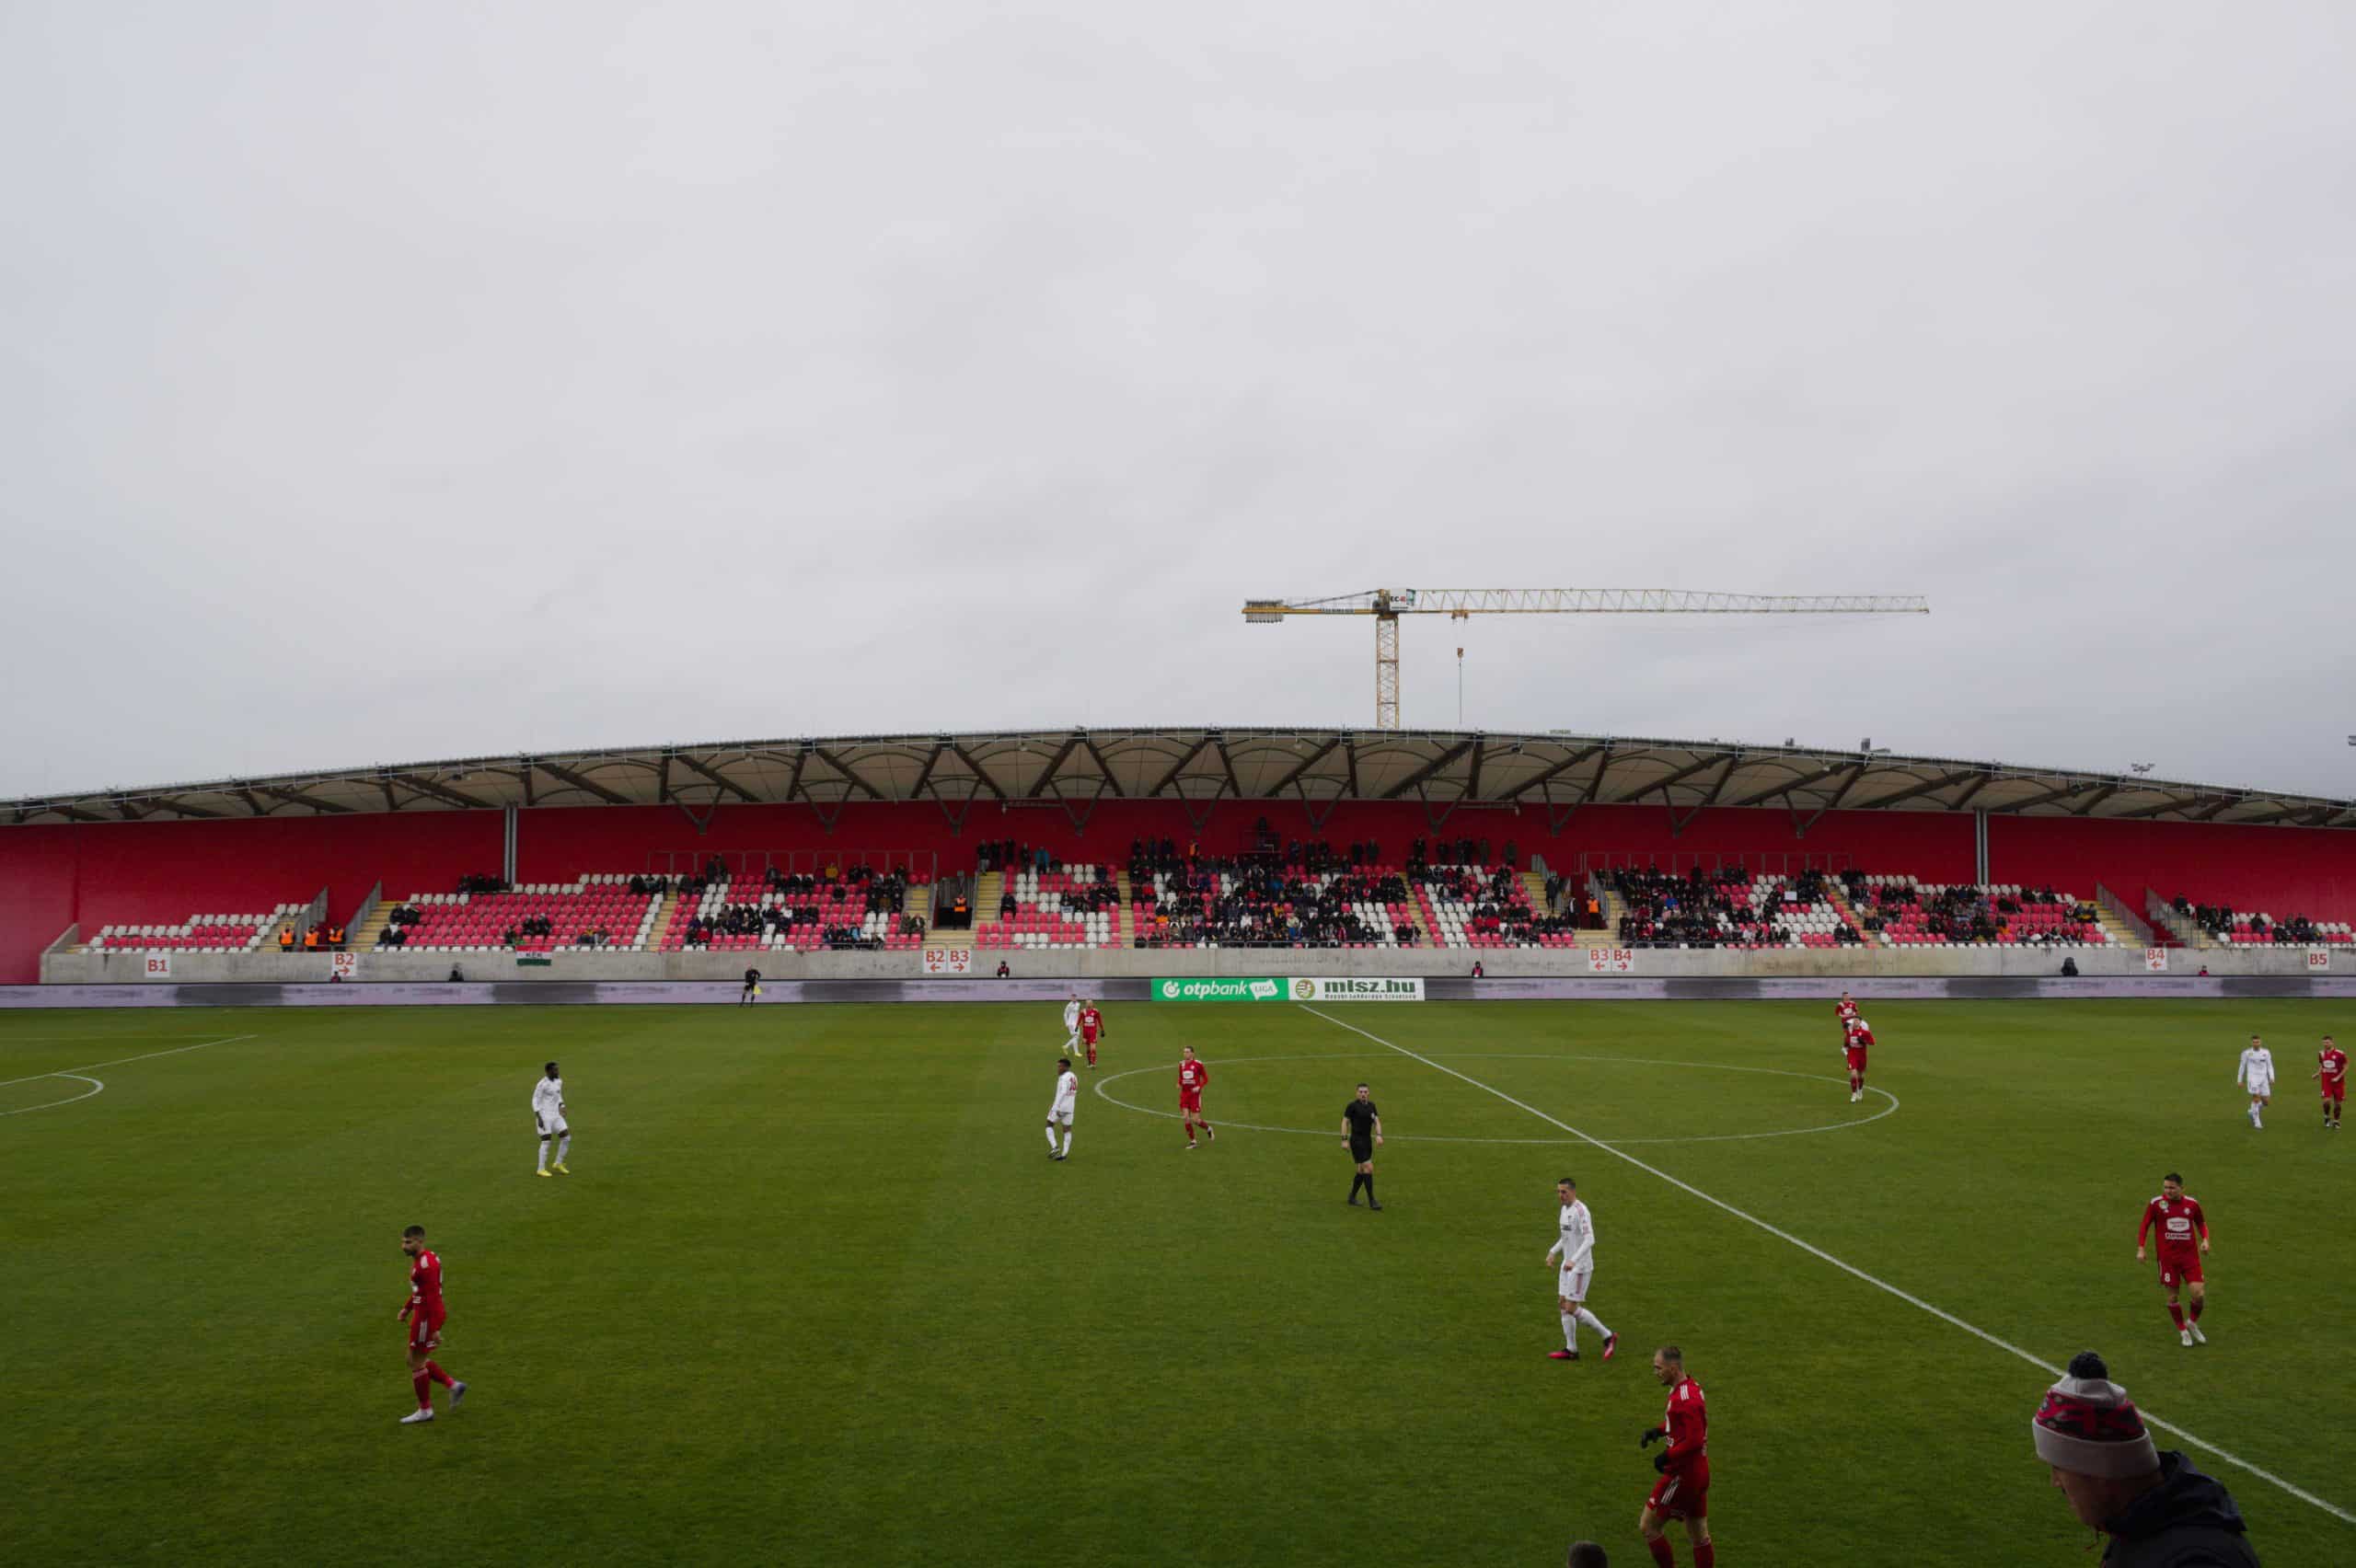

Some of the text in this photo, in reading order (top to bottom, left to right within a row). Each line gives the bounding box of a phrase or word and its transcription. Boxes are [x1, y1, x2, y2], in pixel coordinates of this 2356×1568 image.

[335, 952, 355, 965] B2
[926, 950, 945, 963] B2
[950, 950, 969, 963] B3
[1590, 949, 1609, 961] B3
[1613, 949, 1633, 961] B4
[2146, 948, 2165, 960] B4
[2309, 952, 2327, 965] B5
[147, 959, 167, 972] B1
[1184, 980, 1247, 999] otpbank
[1324, 979, 1415, 993] mlsz.hu
